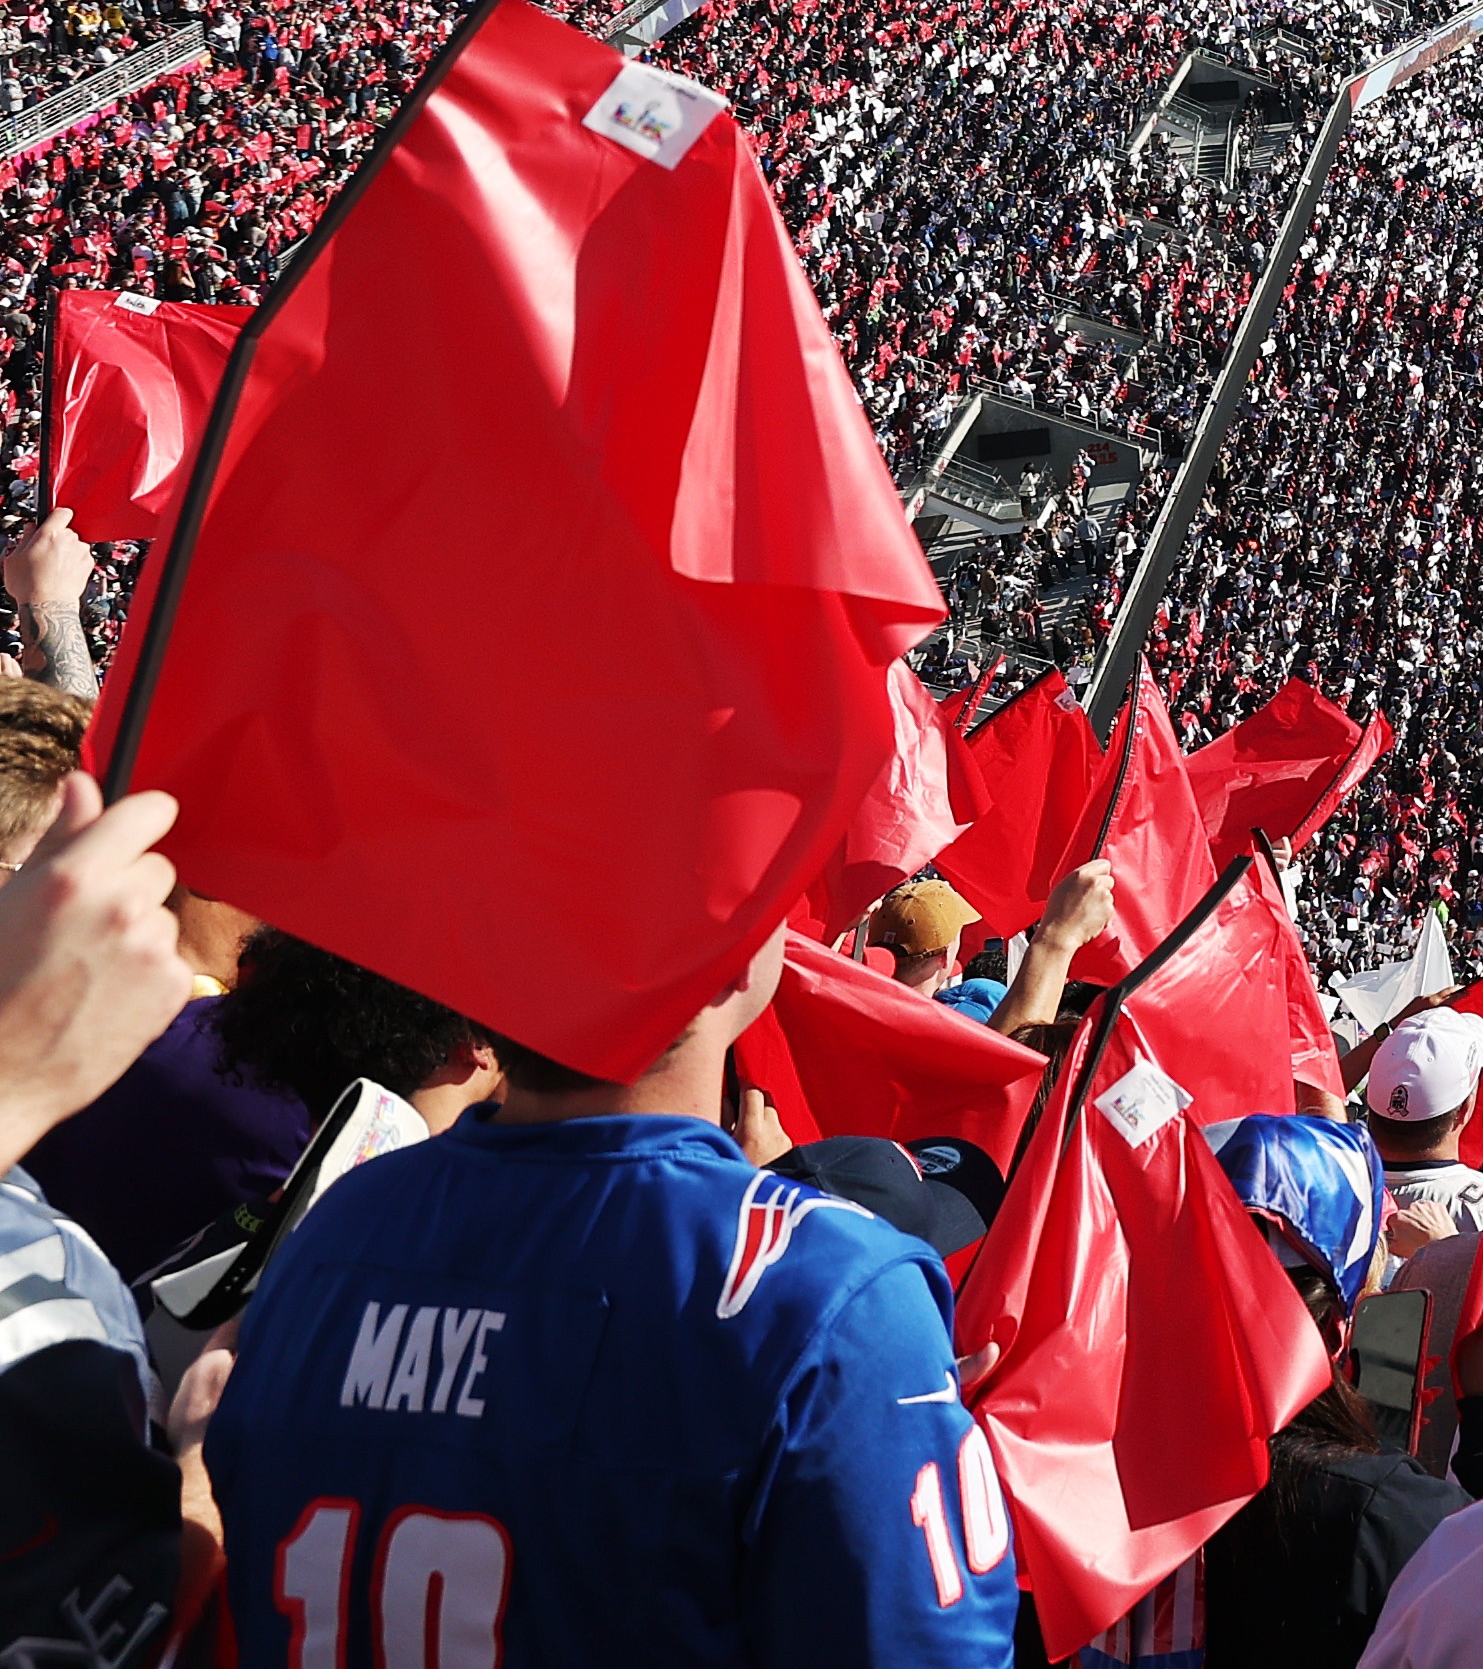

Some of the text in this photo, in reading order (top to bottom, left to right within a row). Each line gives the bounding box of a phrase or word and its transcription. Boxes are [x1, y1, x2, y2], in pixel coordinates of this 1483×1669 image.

[339, 1300, 507, 1419] MAYE
[275, 1495, 515, 1669] 10
[910, 1422, 1010, 1610] 10
